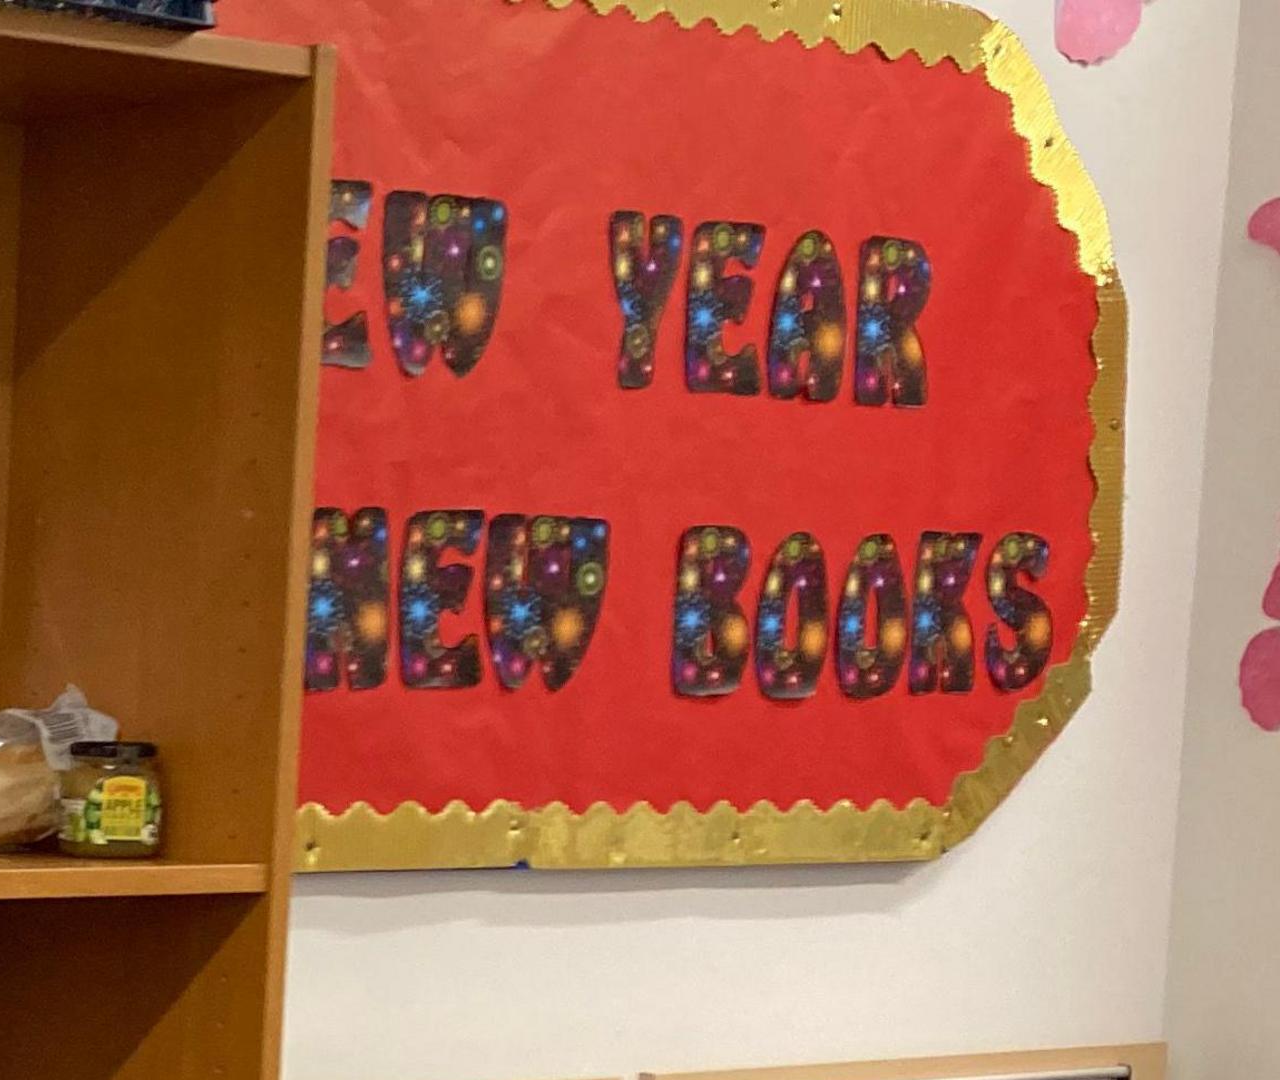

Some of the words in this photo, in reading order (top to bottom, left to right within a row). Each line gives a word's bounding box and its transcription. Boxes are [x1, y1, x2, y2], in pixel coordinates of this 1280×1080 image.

[321, 179, 507, 377] EW
[609, 209, 931, 408] YEAR
[304, 506, 609, 692] NEW
[673, 525, 1053, 701] BOOKS
